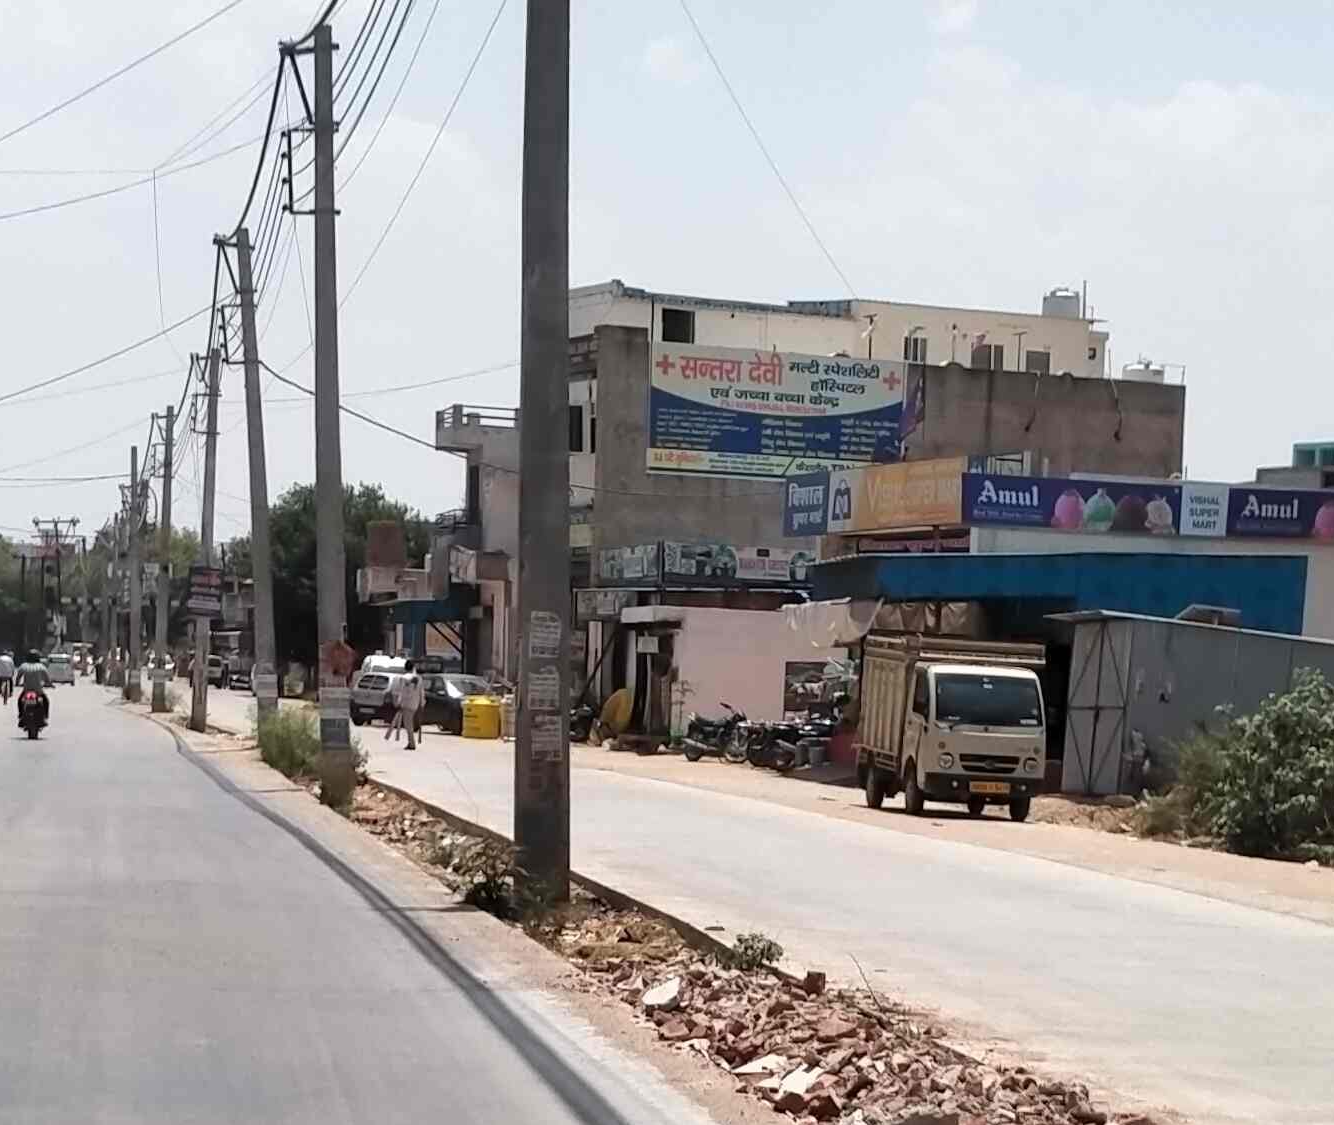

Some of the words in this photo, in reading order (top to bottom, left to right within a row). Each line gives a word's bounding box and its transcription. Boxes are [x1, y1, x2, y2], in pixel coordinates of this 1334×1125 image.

[679, 355, 743, 383] सन्तरा
[748, 351, 785, 386] देवी
[788, 359, 820, 375] मल्टी
[977, 479, 1040, 507] Amul
[1189, 495, 1220, 505] VISHAL
[1189, 507, 1220, 517] SUPER
[1240, 494, 1299, 520] Amul
[1192, 520, 1217, 529] MART
